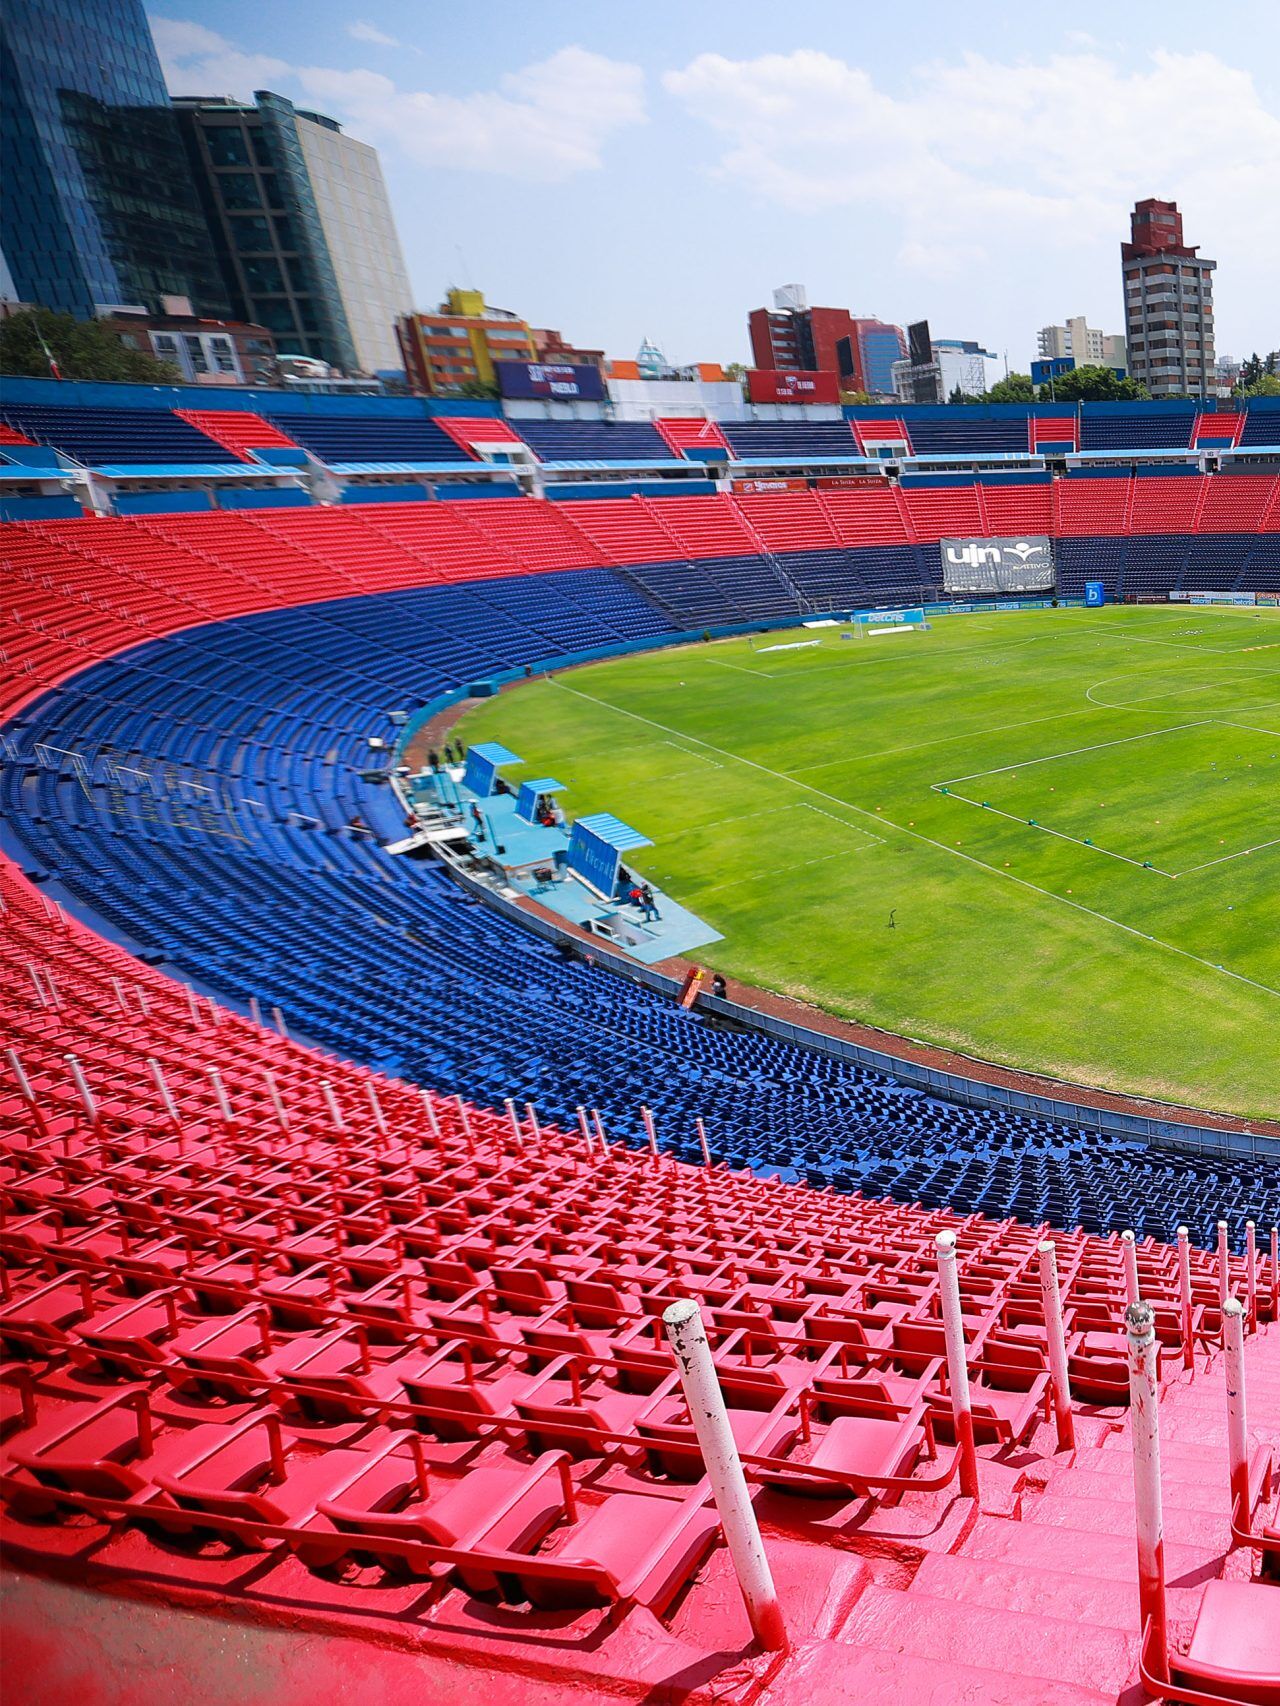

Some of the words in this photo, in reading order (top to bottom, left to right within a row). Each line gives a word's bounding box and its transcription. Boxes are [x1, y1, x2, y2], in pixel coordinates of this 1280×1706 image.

[1088, 589, 1098, 601] b
[996, 602, 1020, 610] betcris
[868, 612, 906, 625] betcris
